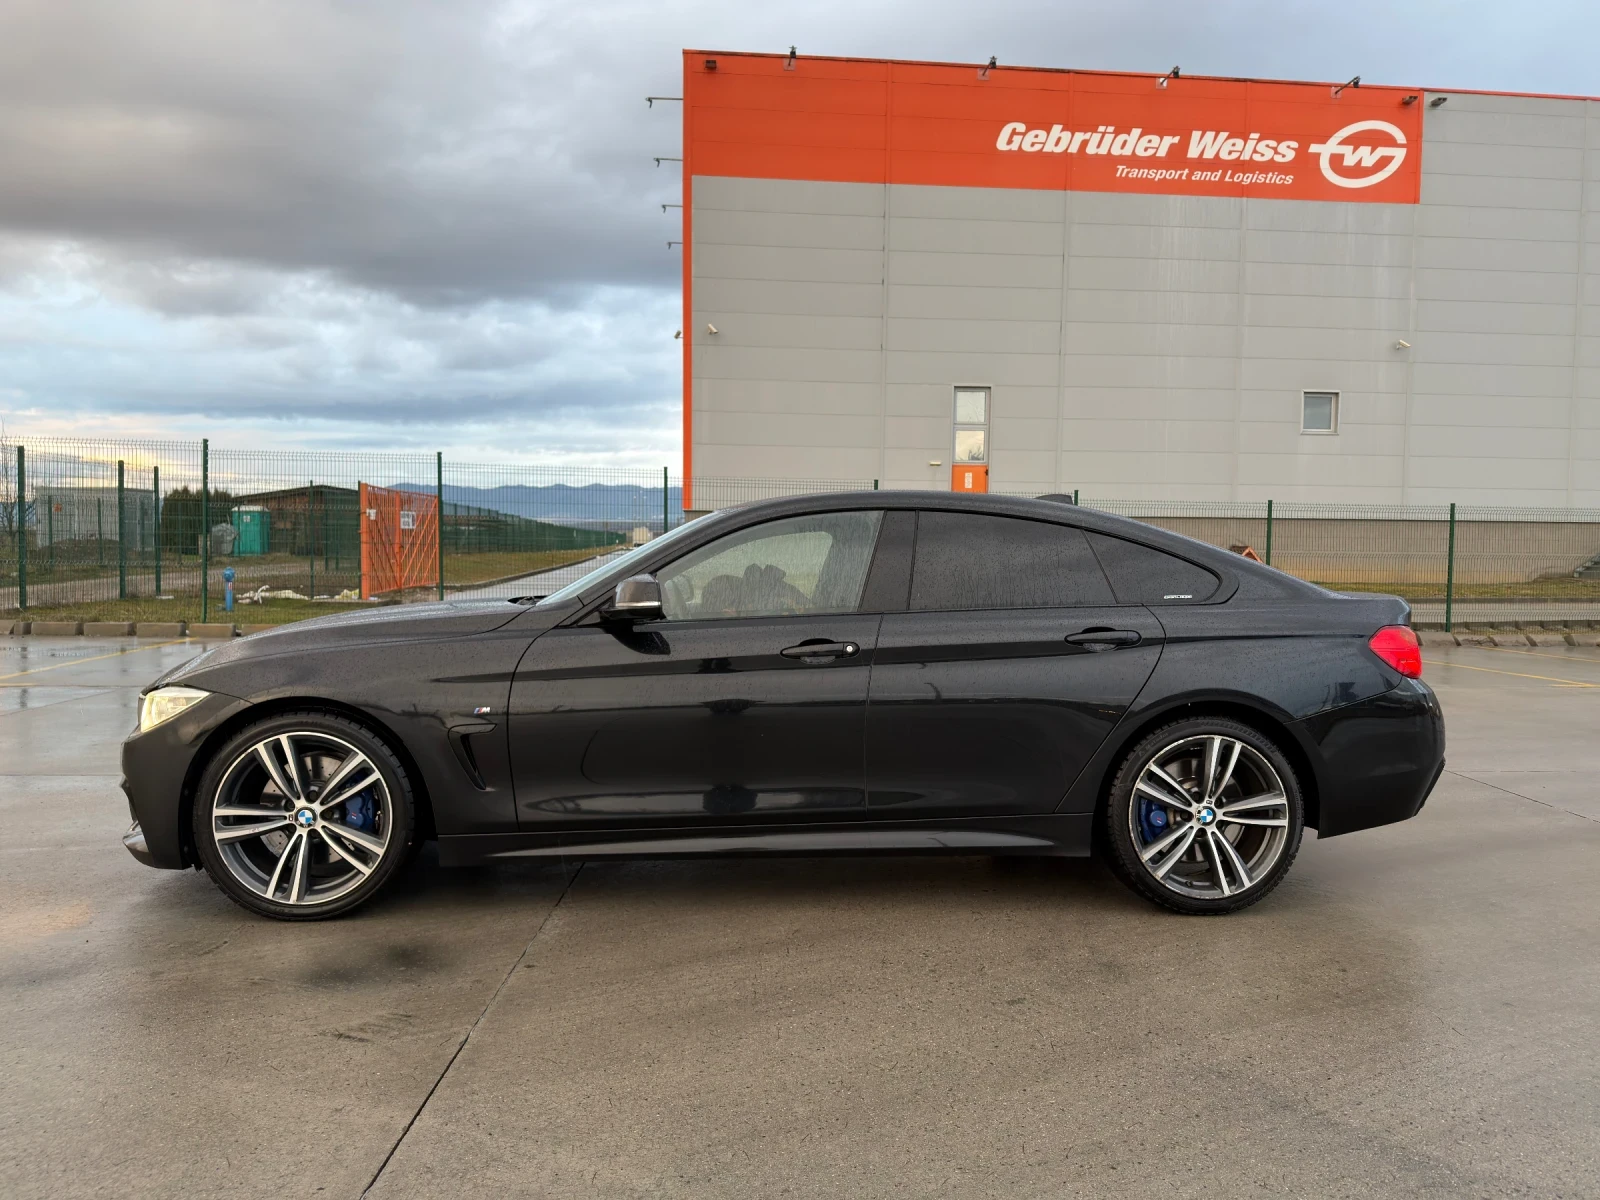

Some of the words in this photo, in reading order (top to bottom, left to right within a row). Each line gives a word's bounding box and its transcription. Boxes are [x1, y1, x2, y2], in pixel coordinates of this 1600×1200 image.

[995, 121, 1181, 157] Gebrüder
[1186, 130, 1299, 163] Weiss
[1115, 165, 1190, 182] Transport
[1191, 169, 1223, 182] and
[1224, 169, 1294, 185] Logistics
